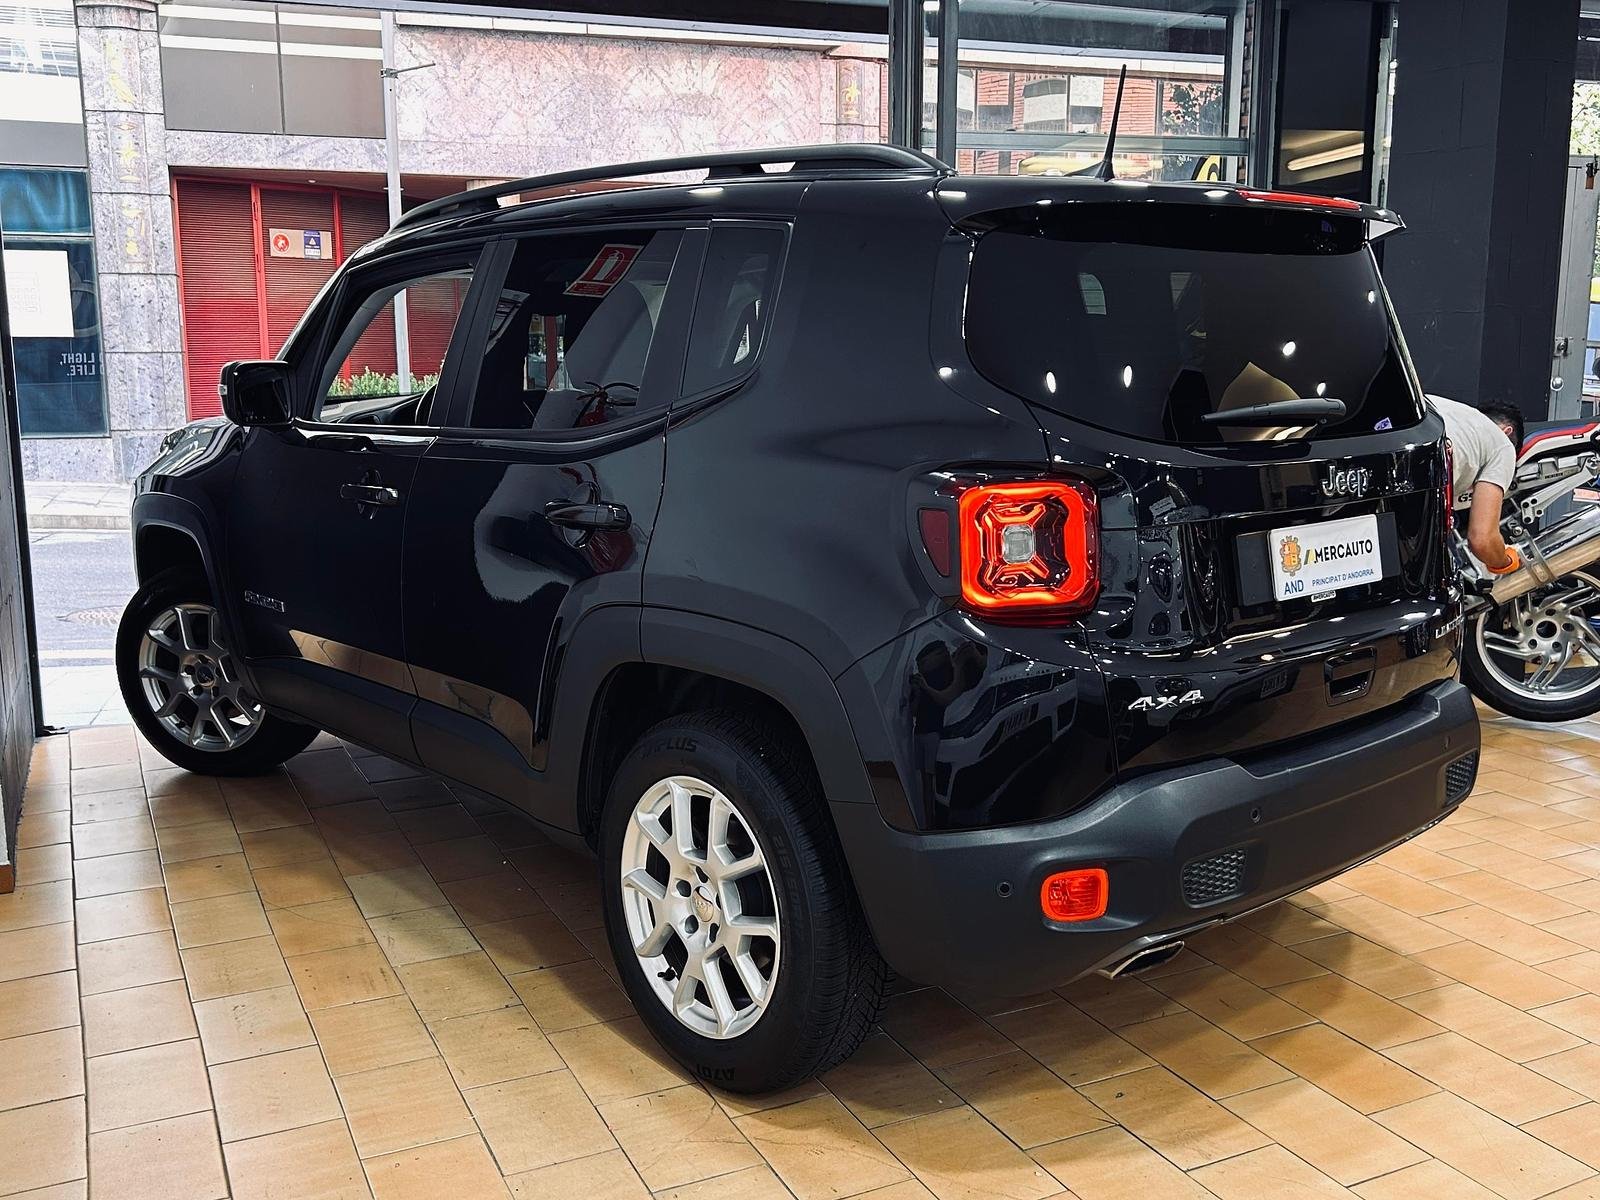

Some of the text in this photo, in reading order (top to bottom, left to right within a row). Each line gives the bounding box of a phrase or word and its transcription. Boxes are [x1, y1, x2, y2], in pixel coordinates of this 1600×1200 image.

[1322, 465, 1369, 497] Jeep
[1315, 539, 1373, 563] MERCAUTO
[1284, 579, 1305, 595] AND
[1312, 568, 1374, 587] PRINCIPAT D'ANDORRA
